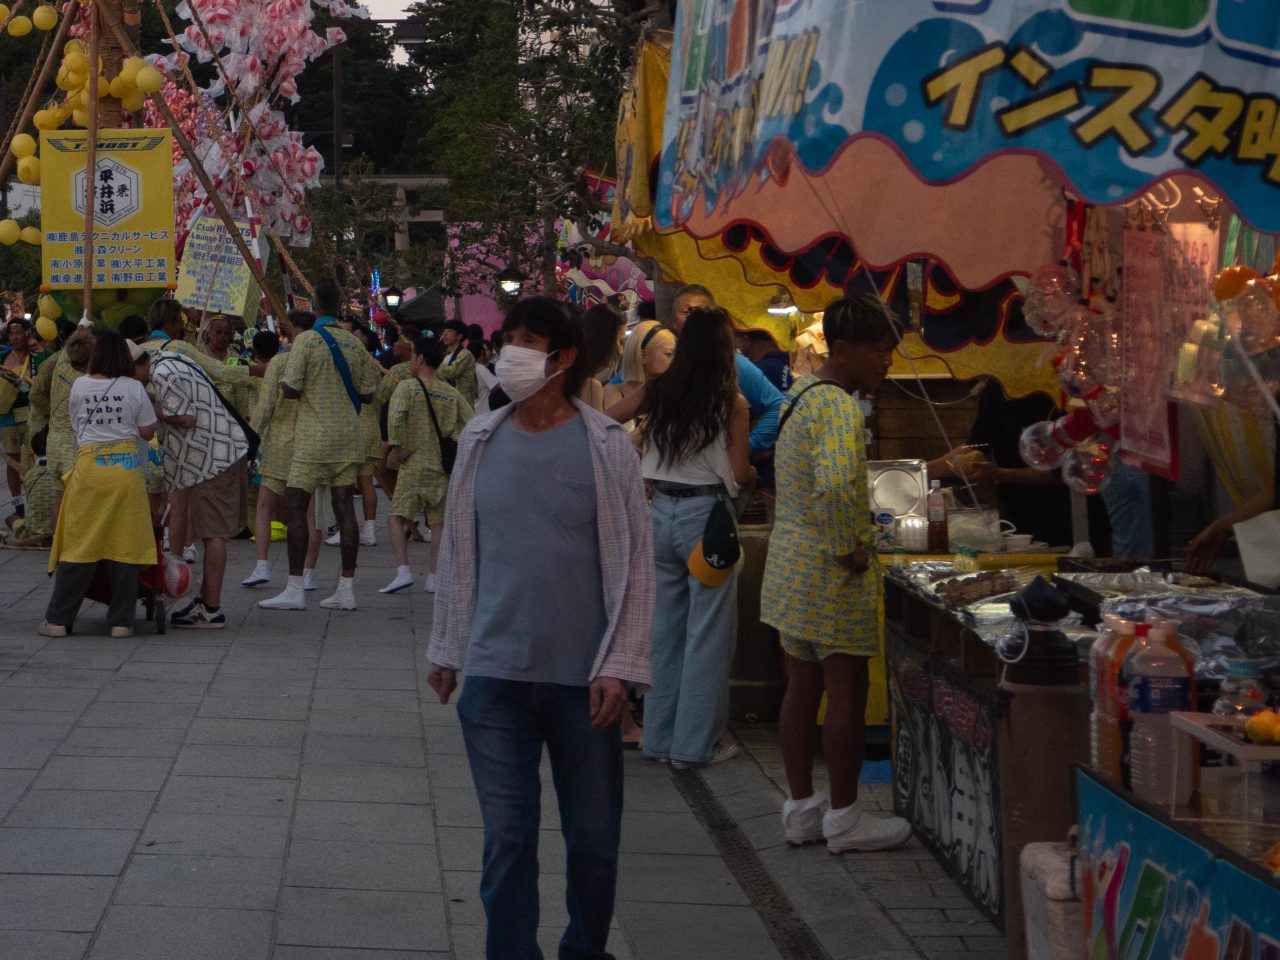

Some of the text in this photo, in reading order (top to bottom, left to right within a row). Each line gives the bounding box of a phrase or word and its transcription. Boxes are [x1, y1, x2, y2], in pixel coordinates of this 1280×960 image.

[84, 395, 123, 404] slow
[86, 405, 123, 415] babe
[86, 416, 123, 425] surf
